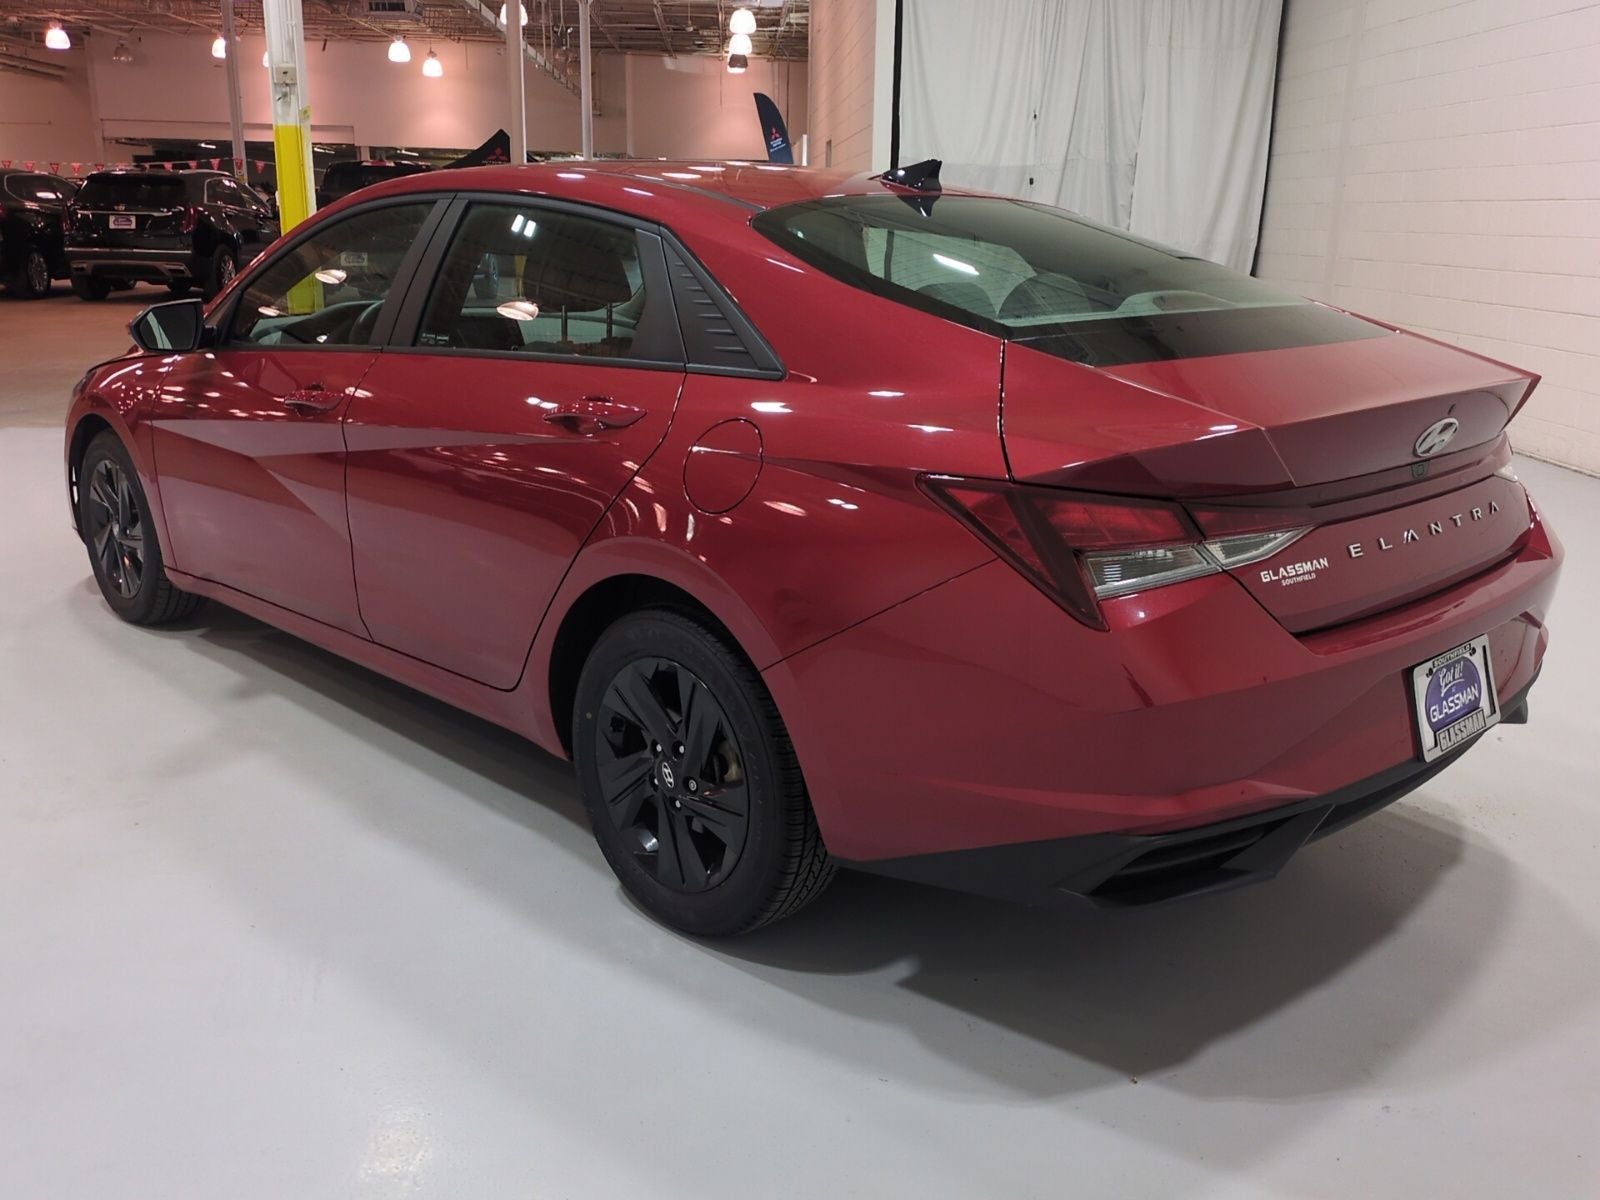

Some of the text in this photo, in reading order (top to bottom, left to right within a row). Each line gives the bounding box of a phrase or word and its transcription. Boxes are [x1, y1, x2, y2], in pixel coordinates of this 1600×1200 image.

[1348, 501, 1500, 558] ELANTRA
[1260, 557, 1329, 582] GLASSMAN
[1281, 572, 1317, 586] SOUTHFIELD
[1439, 666, 1454, 692] Got
[1429, 683, 1479, 722] GLASSMAN
[1439, 711, 1486, 752] GLASSMAN
